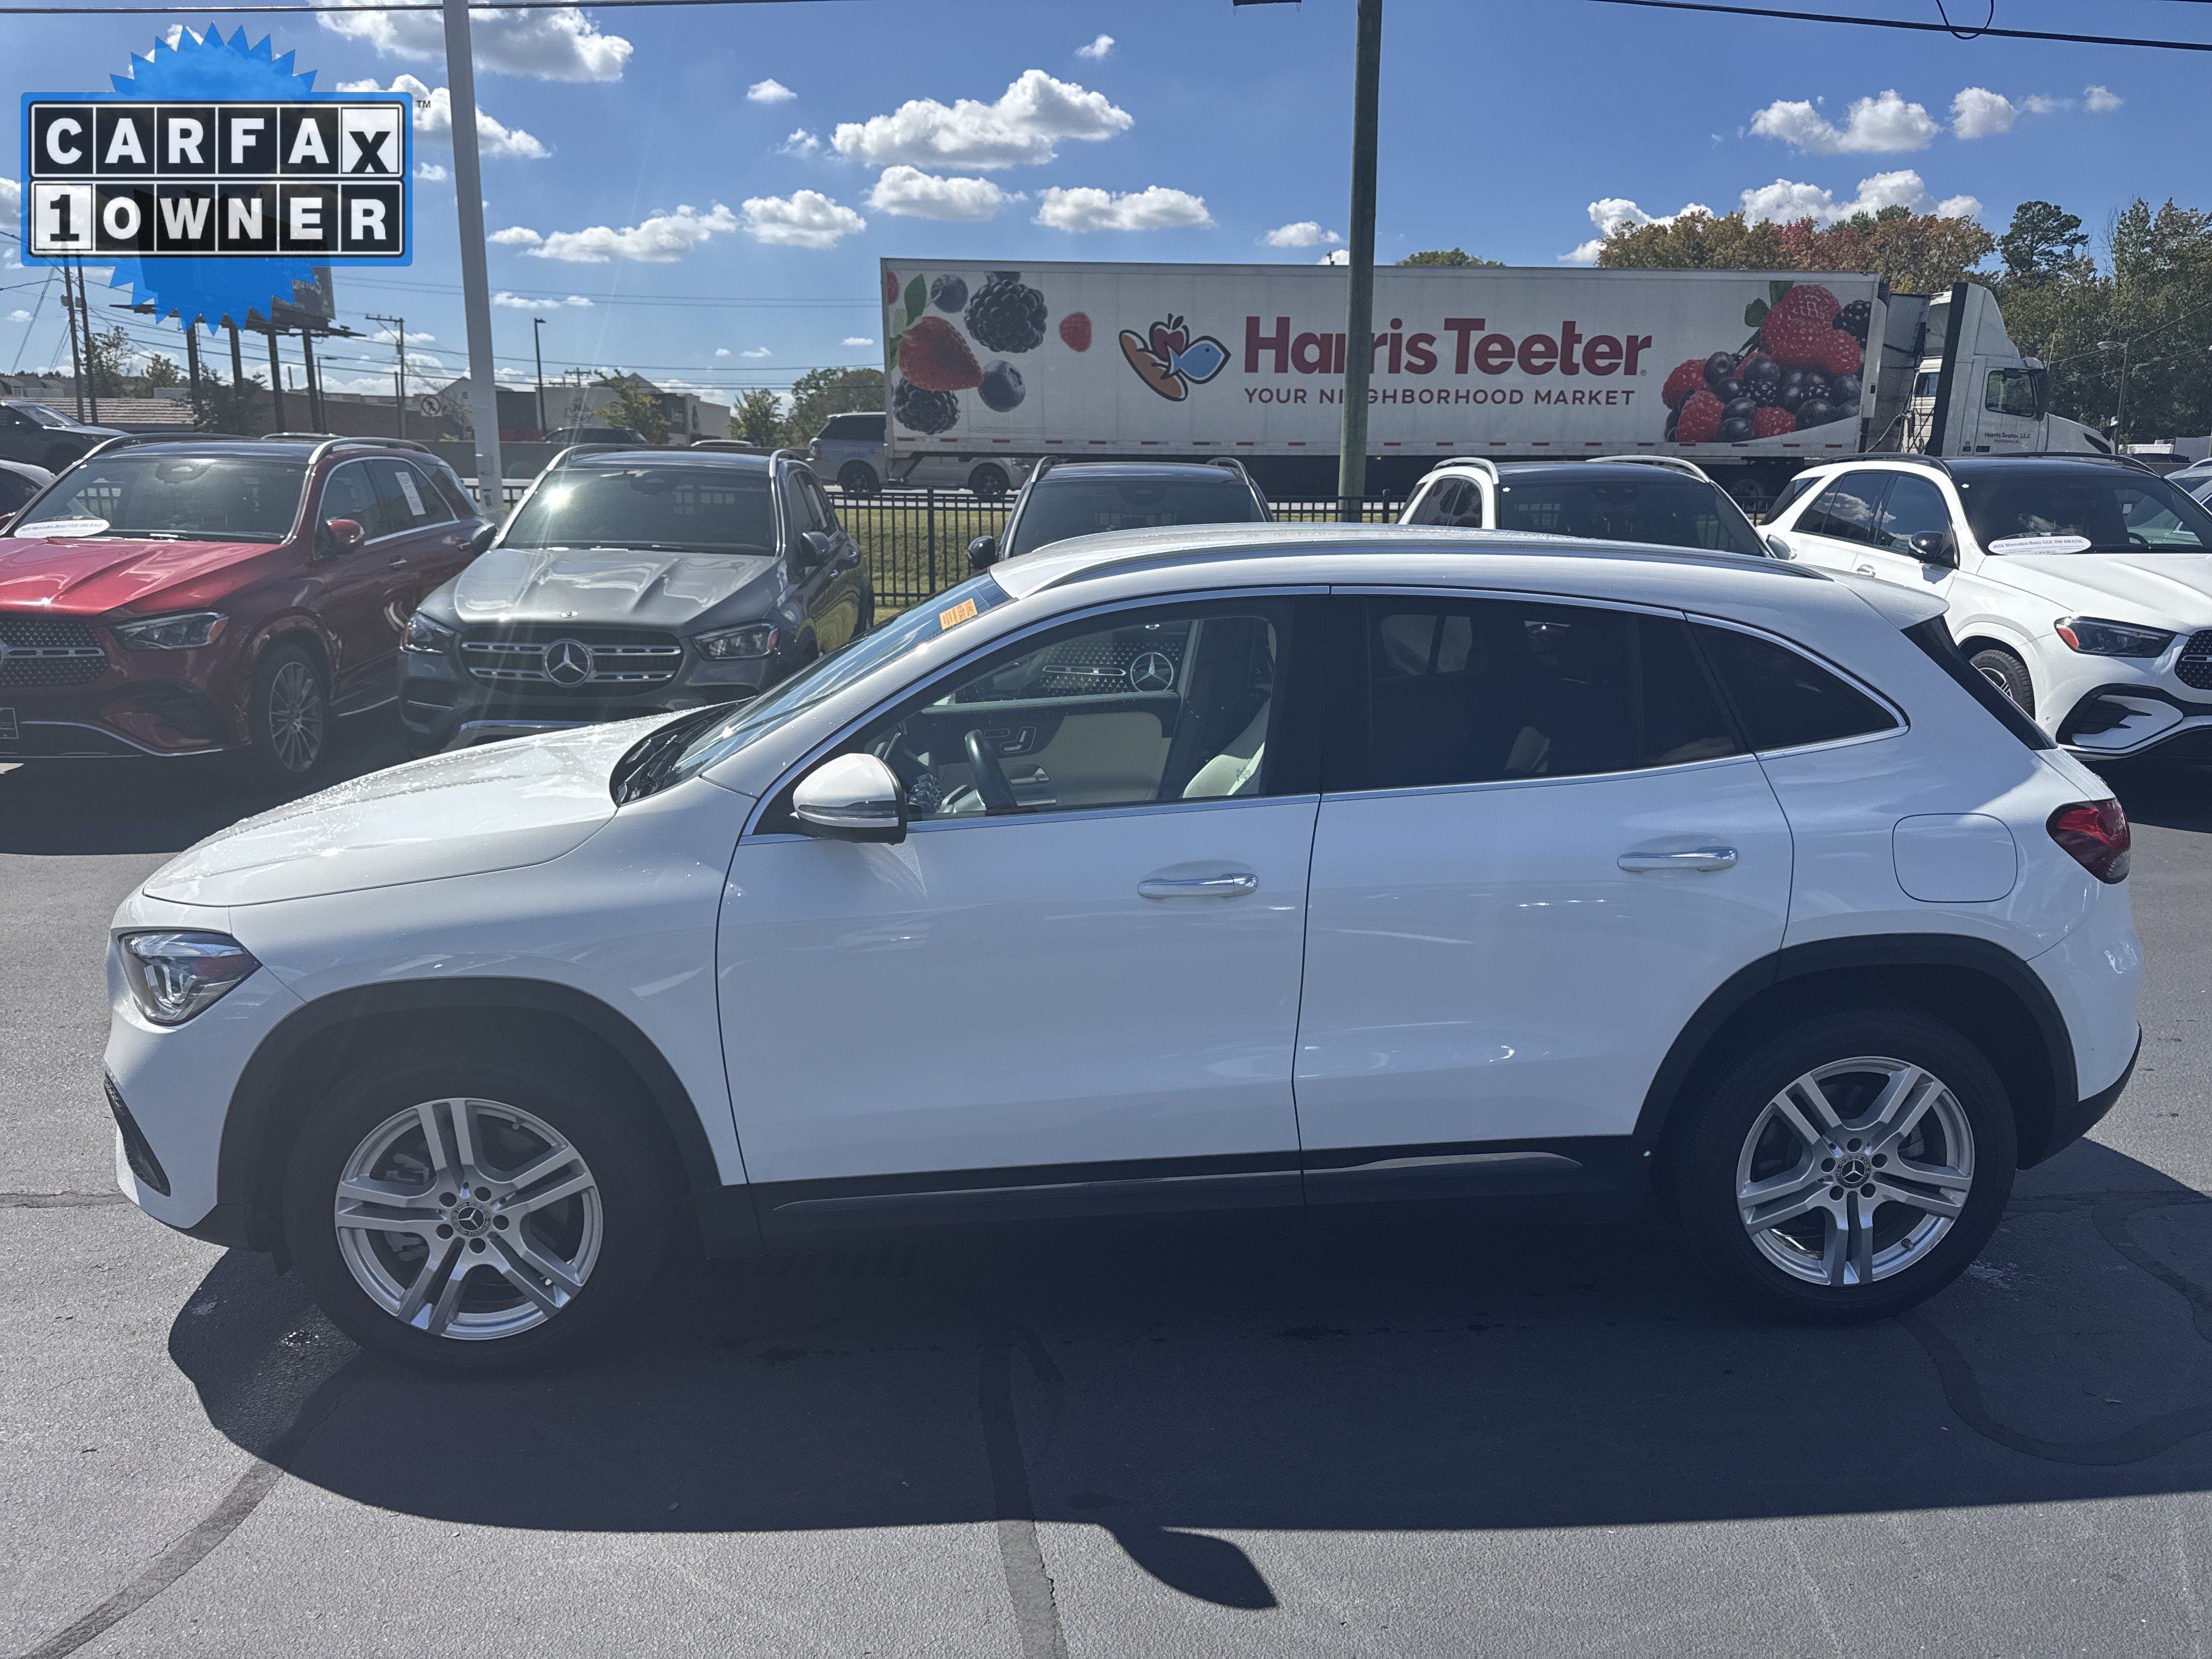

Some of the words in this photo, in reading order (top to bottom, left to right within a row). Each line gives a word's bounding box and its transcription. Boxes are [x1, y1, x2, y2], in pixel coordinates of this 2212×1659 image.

[1444, 318, 1652, 376] Teeter
[1244, 388, 1307, 404] YOUR
[1319, 388, 1523, 404] NGHBORHOOD
[1534, 390, 1635, 405] MARKET
